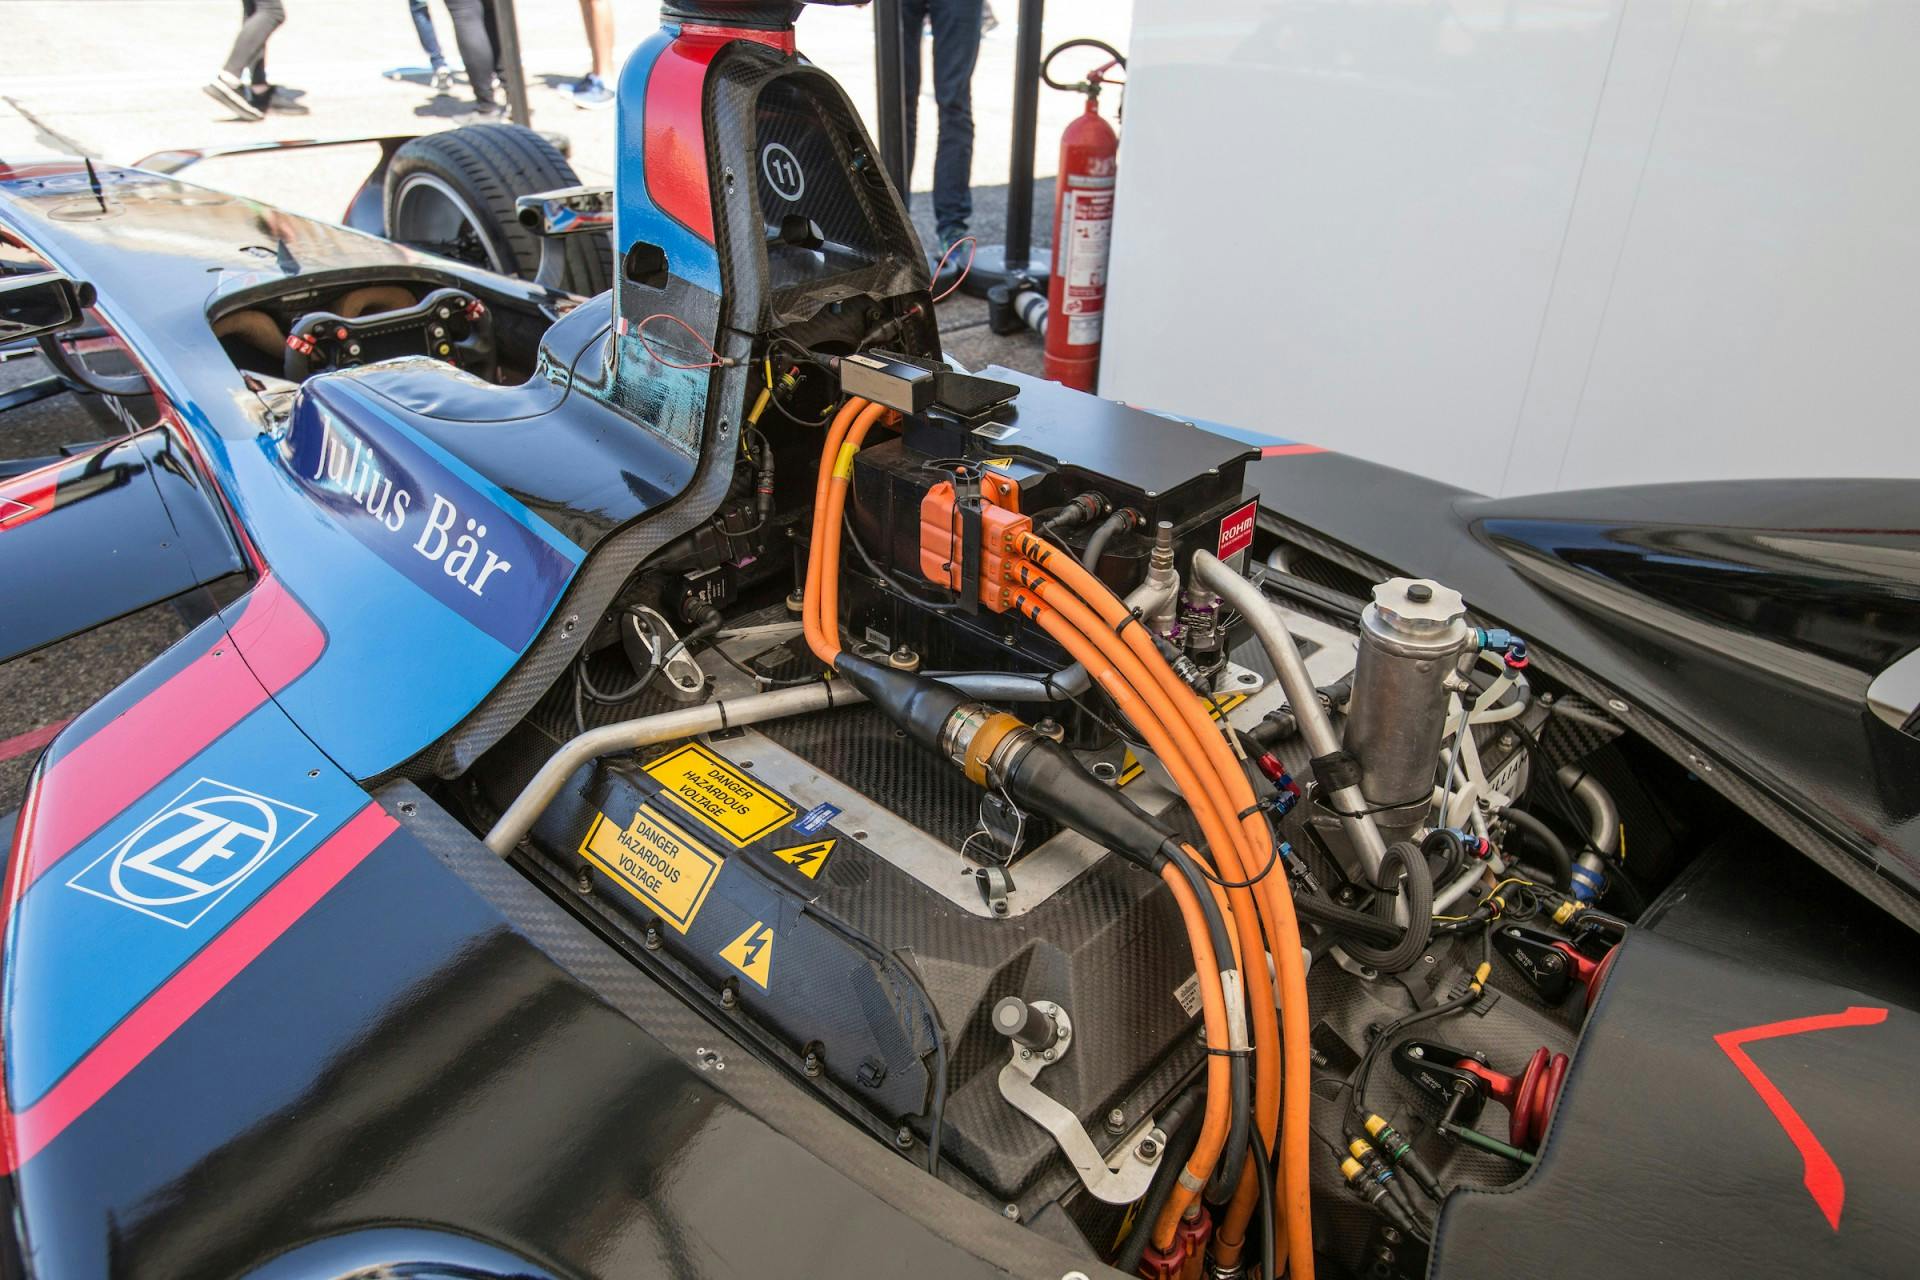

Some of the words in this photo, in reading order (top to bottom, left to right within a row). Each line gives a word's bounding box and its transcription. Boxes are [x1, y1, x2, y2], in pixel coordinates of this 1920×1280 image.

[772, 160, 795, 186] 11
[314, 414, 411, 532] Julius
[412, 493, 512, 597] Bär
[1222, 517, 1252, 543] ROHM
[679, 784, 726, 817] VOLTAGE
[682, 770, 752, 815] HAZARDOUS
[707, 769, 754, 800] DANGER
[120, 806, 270, 893] ZF
[617, 830, 681, 883] HAZARDOUS
[636, 821, 681, 859] DANGER
[618, 854, 663, 894] VOLTAGE
